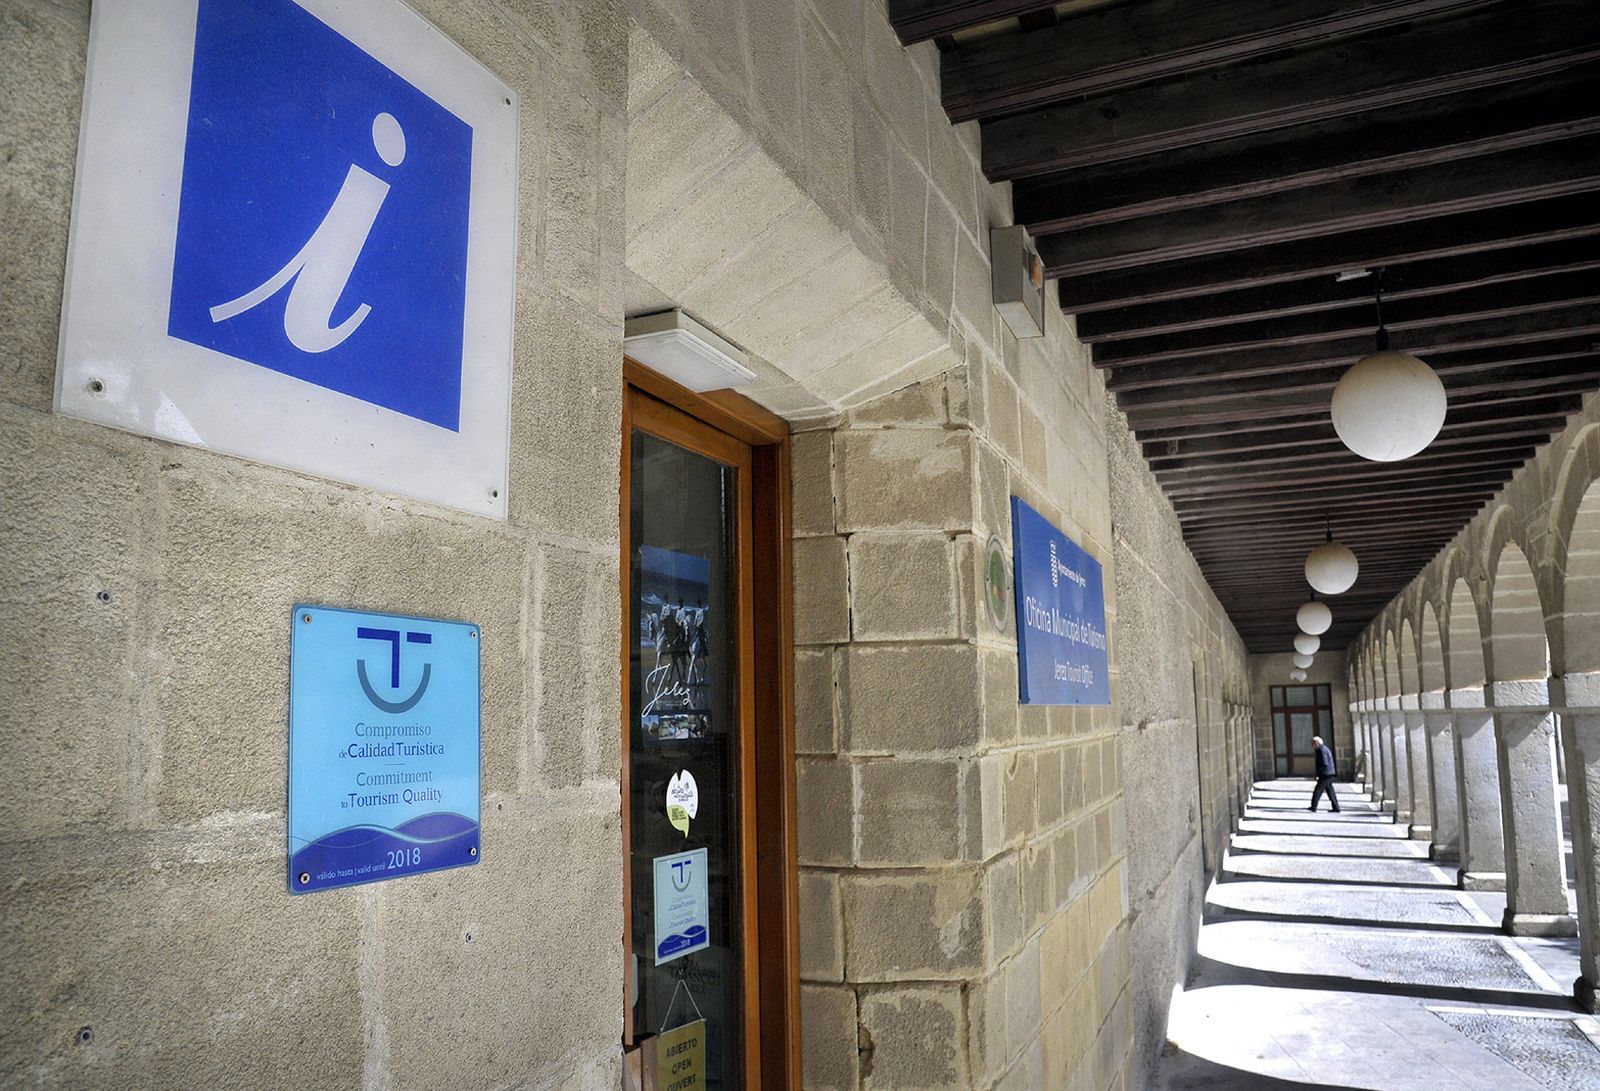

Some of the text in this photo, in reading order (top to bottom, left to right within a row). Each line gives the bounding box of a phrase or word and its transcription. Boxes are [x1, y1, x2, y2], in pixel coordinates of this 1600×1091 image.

[210, 112, 406, 353] i
[1026, 595, 1106, 650] Oficina Municipal de Turismo
[1054, 659, 1093, 688] Jerez Tourist Office
[642, 663, 692, 717] Jerez
[355, 722, 431, 740] Compromiso
[339, 749, 347, 759] de
[348, 742, 395, 758] Calidad
[356, 770, 433, 787] Commitment
[341, 787, 443, 809] to Tourism Quality
[316, 870, 336, 881] válido
[337, 868, 354, 879] hasta
[372, 862, 386, 873] until
[387, 847, 421, 870] 2018
[666, 1038, 698, 1058] ABIERTO
[672, 1057, 692, 1075] OPEN
